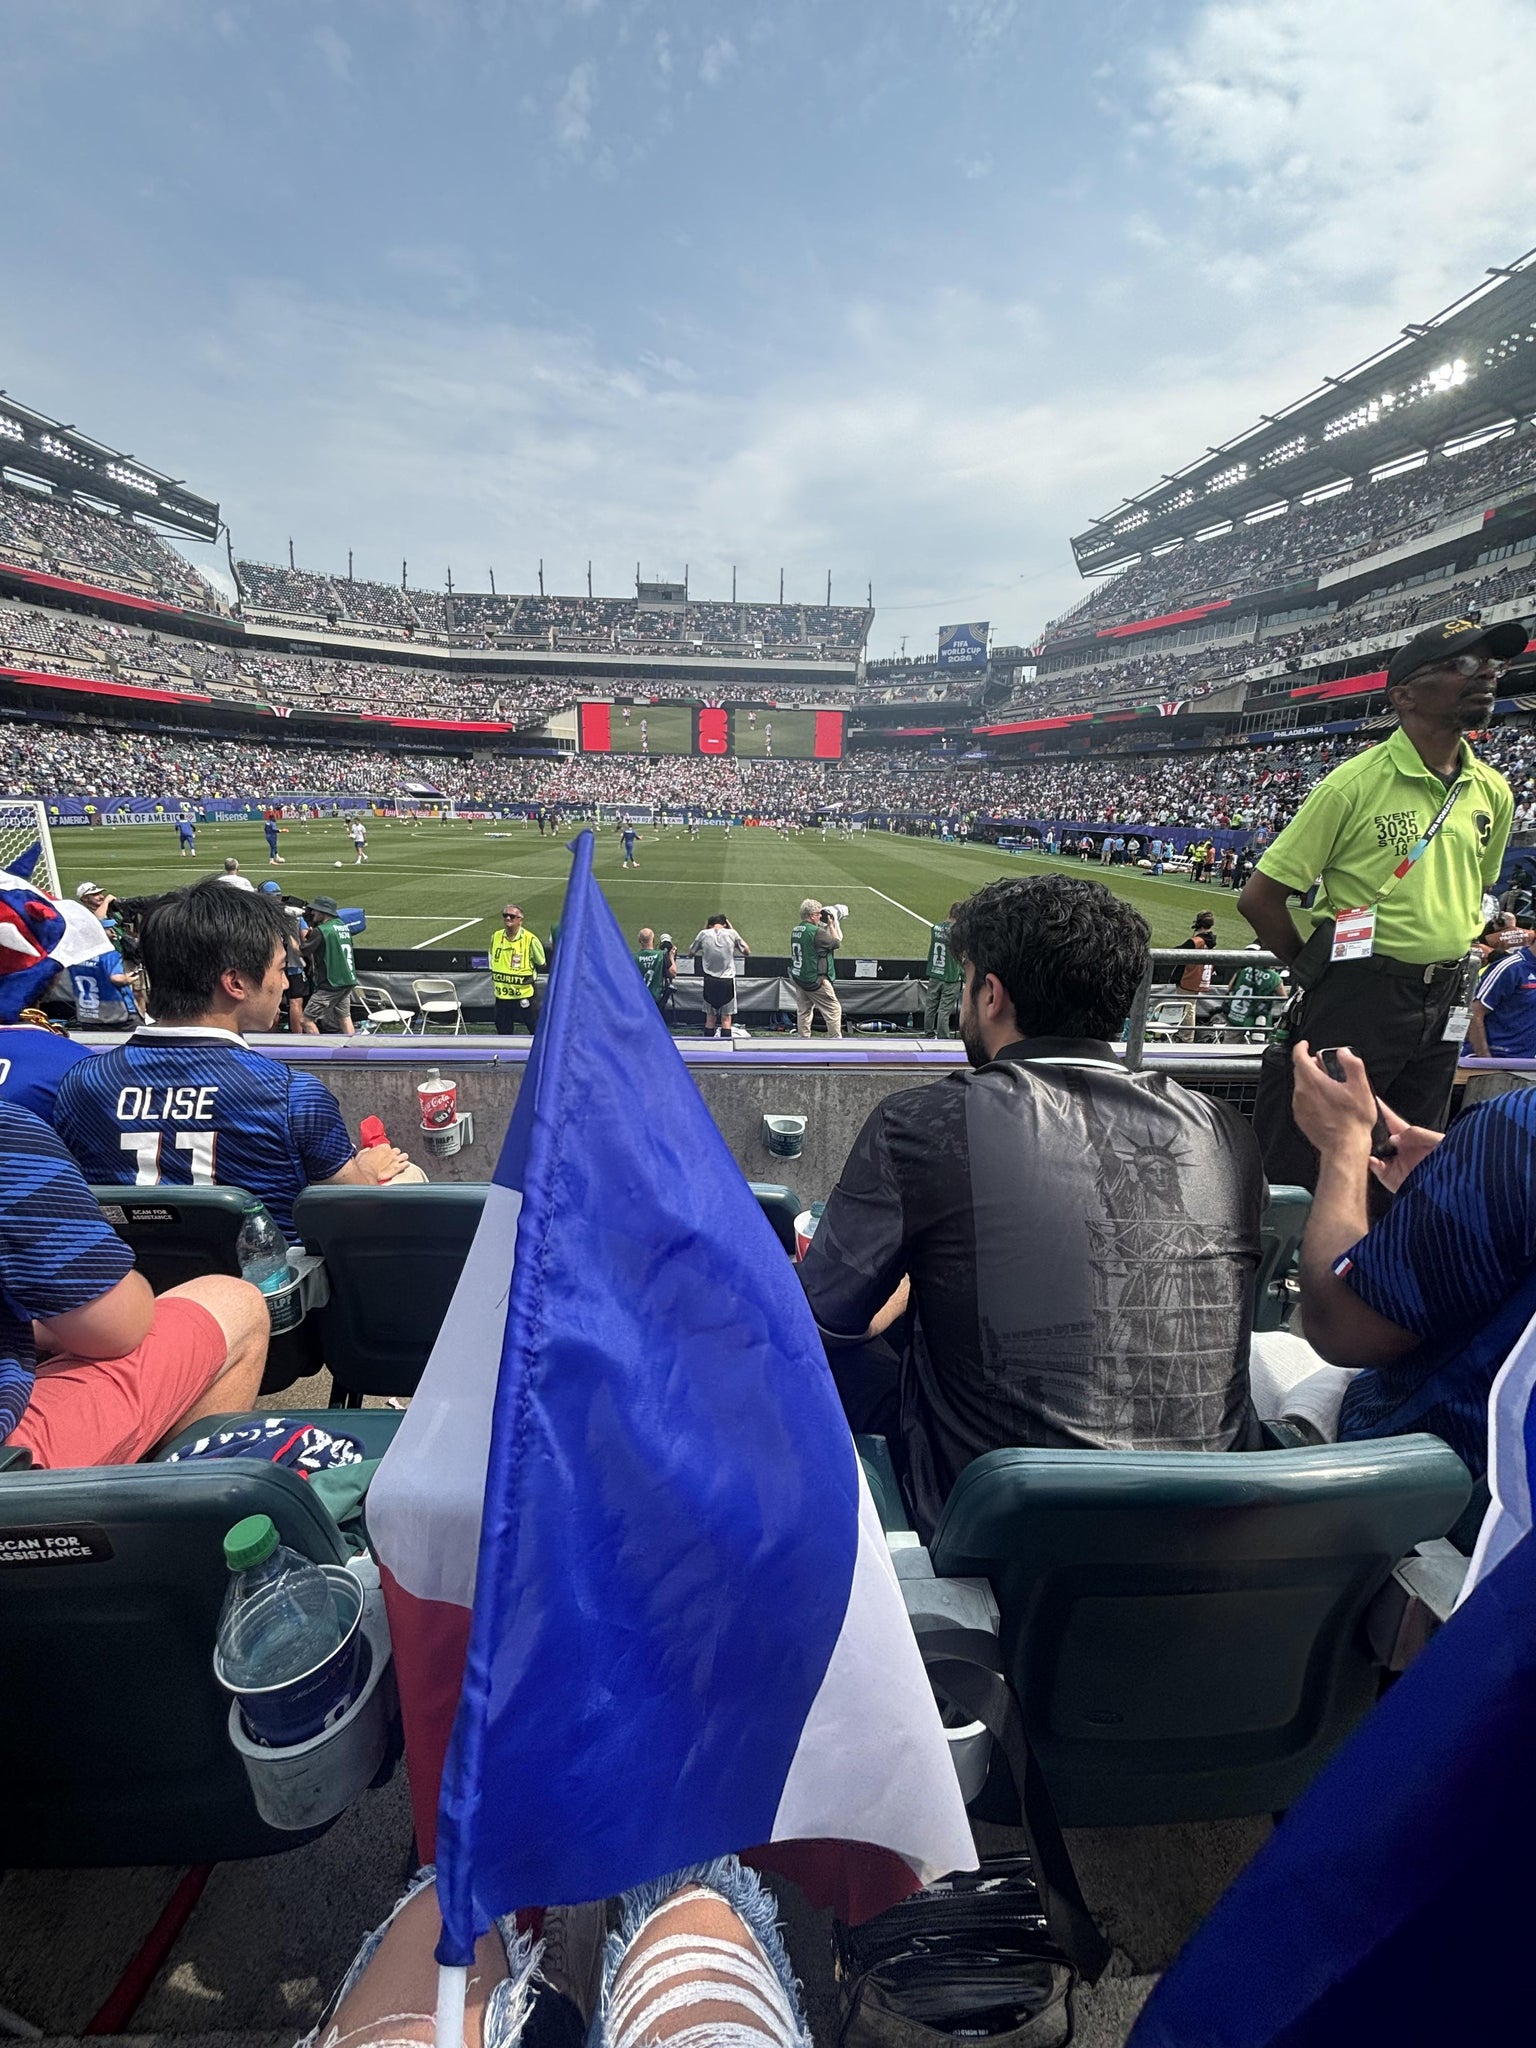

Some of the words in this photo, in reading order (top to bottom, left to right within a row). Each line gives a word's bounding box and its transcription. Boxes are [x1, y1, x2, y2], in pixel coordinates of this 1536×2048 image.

[953, 640, 969, 648] FIFA
[941, 648, 966, 656] WORLD
[966, 647, 981, 655] CUP
[947, 655, 973, 663] 2026
[1273, 726, 1324, 738] PHILADELPHIA
[60, 816, 90, 825] AMERICA
[106, 814, 133, 824] BANK
[134, 814, 146, 823] OF
[148, 813, 181, 823] AMERIC
[215, 811, 248, 822] Hisense
[1374, 811, 1417, 824] EVENT
[1427, 823, 1440, 836] FIFA
[1435, 803, 1451, 824] WORLD
[1376, 819, 1418, 840] 3035
[1378, 834, 1421, 847] STAFF
[1394, 844, 1408, 856] 18
[493, 973, 525, 984] ECURITY
[116, 1086, 219, 1121] OLISE
[44, 1536, 80, 1548] FOR
